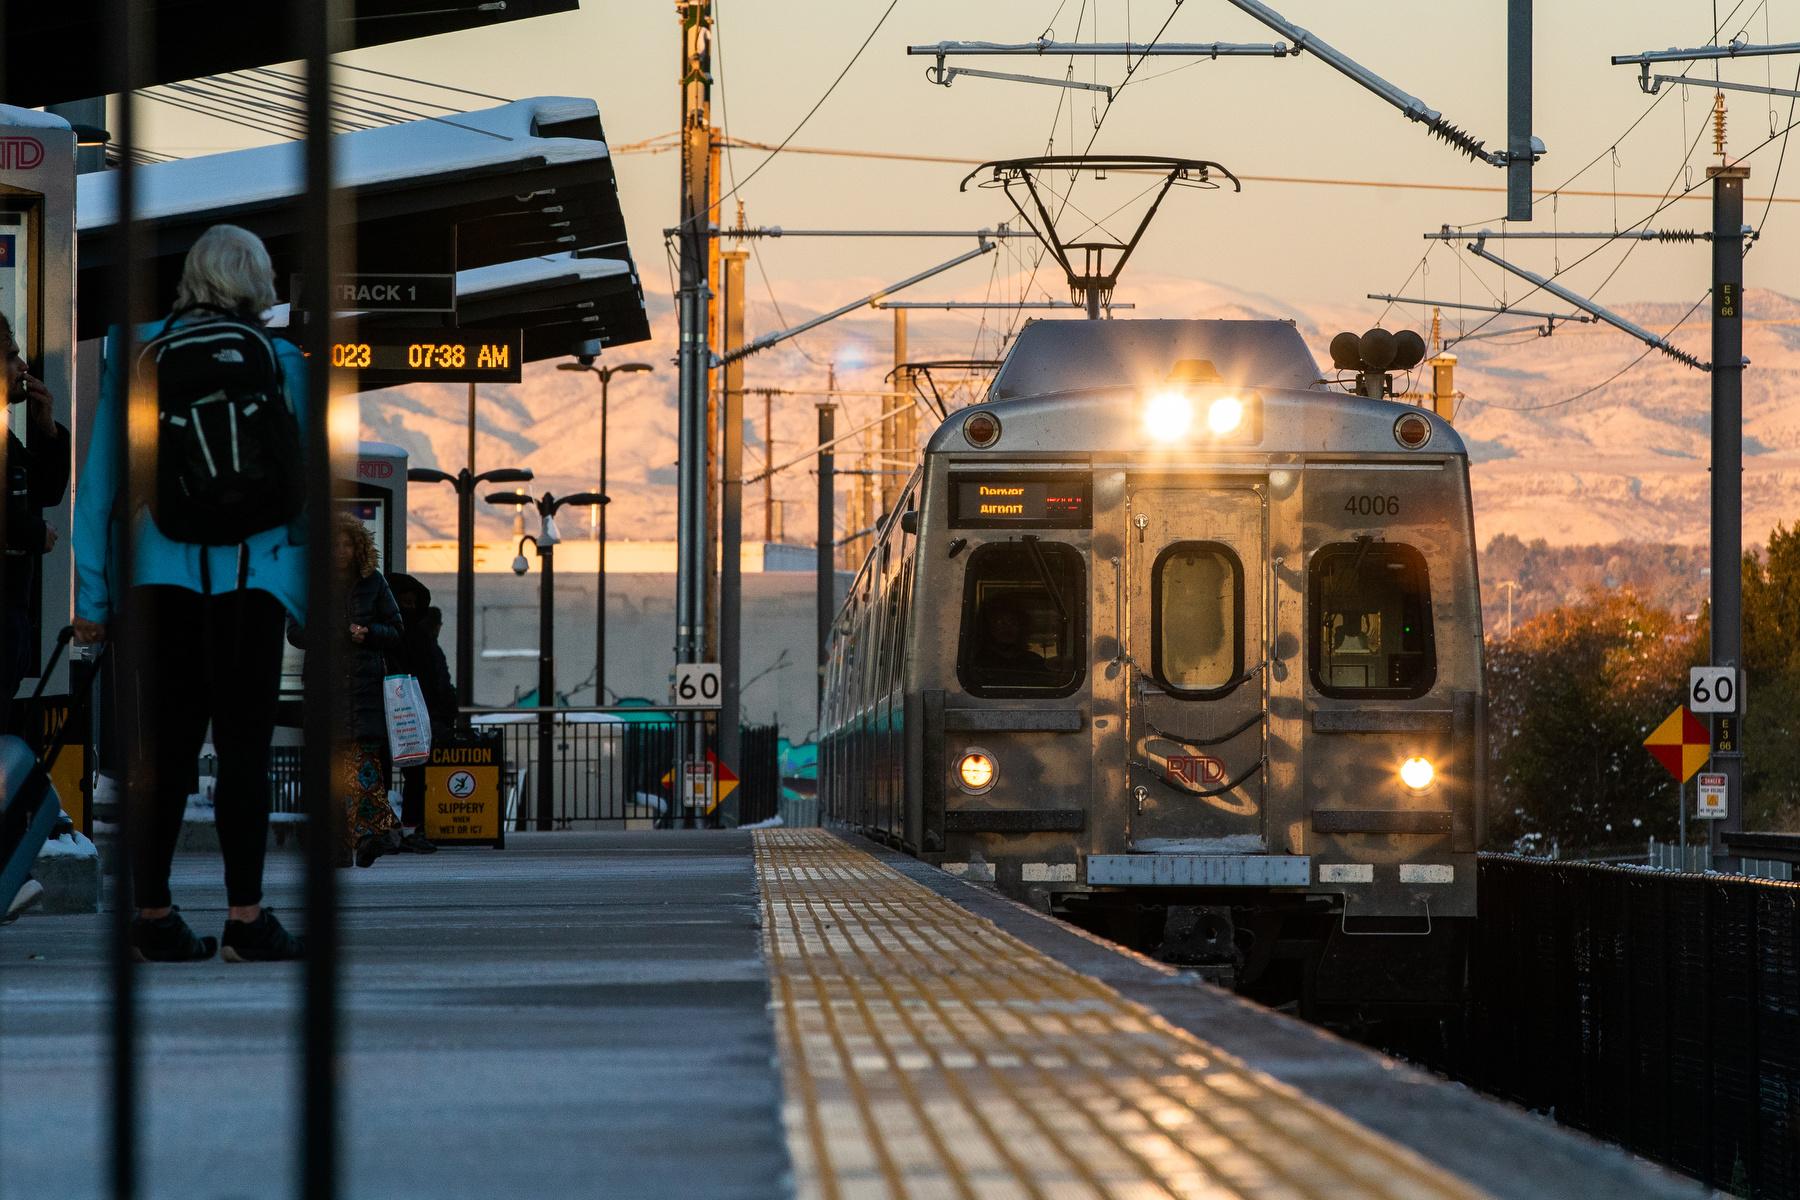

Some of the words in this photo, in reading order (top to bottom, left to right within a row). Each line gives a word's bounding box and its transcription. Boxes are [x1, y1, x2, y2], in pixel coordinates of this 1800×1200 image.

[0, 136, 45, 170] TD
[408, 285, 416, 301] 1
[1724, 284, 1731, 294] E
[1724, 295, 1731, 305] 3
[1721, 307, 1734, 316] 66
[332, 344, 371, 368] 023
[408, 344, 465, 368] 07:38
[477, 345, 509, 368] AM
[357, 461, 393, 478] RTD
[1344, 495, 1400, 515] 4006
[678, 673, 719, 699] 60
[1693, 676, 1733, 703] 60
[1722, 719, 1729, 728] E
[1722, 730, 1729, 739] 3
[1720, 741, 1732, 750] 66
[432, 748, 491, 763] CAUTION
[1167, 755, 1226, 783] RTD
[438, 803, 485, 814] SLIPPERY
[440, 825, 456, 834] WET
[457, 825, 468, 834] OR
[470, 825, 482, 834] ICY
